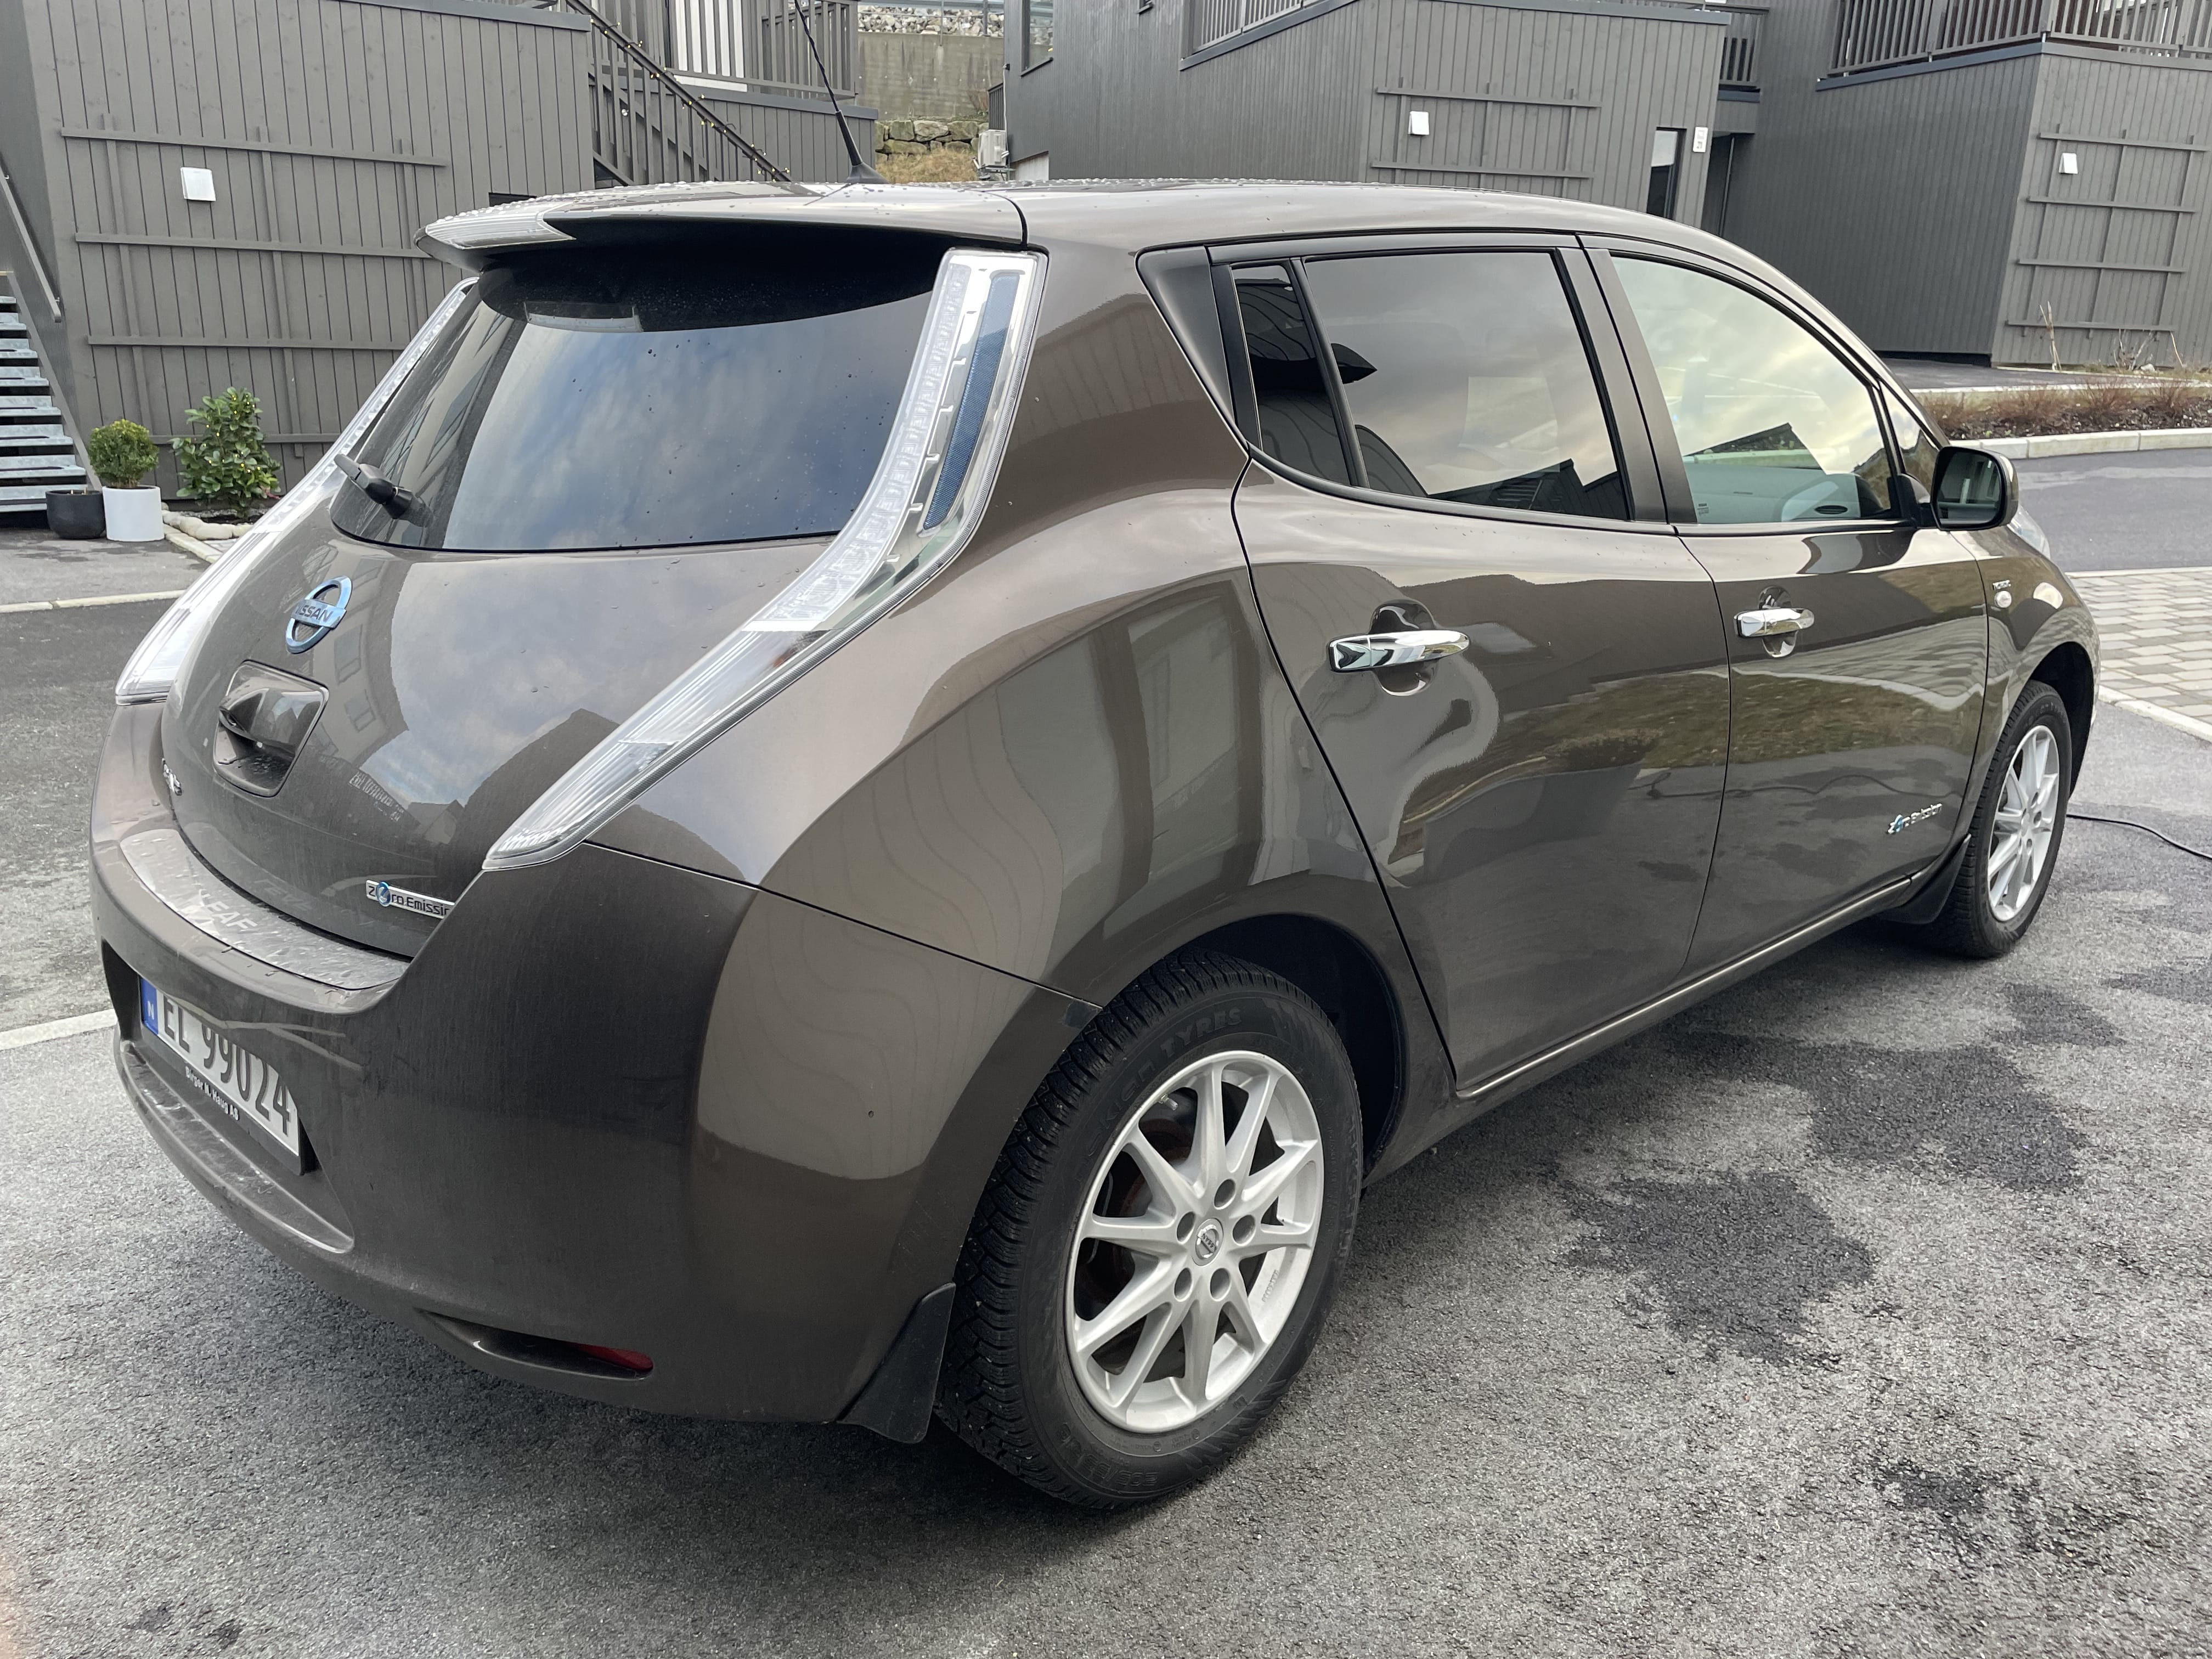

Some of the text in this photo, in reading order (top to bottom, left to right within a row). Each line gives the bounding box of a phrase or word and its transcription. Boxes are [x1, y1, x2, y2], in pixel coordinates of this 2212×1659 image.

[147, 1000, 155, 1020] N
[163, 996, 291, 1137] EL 99024
